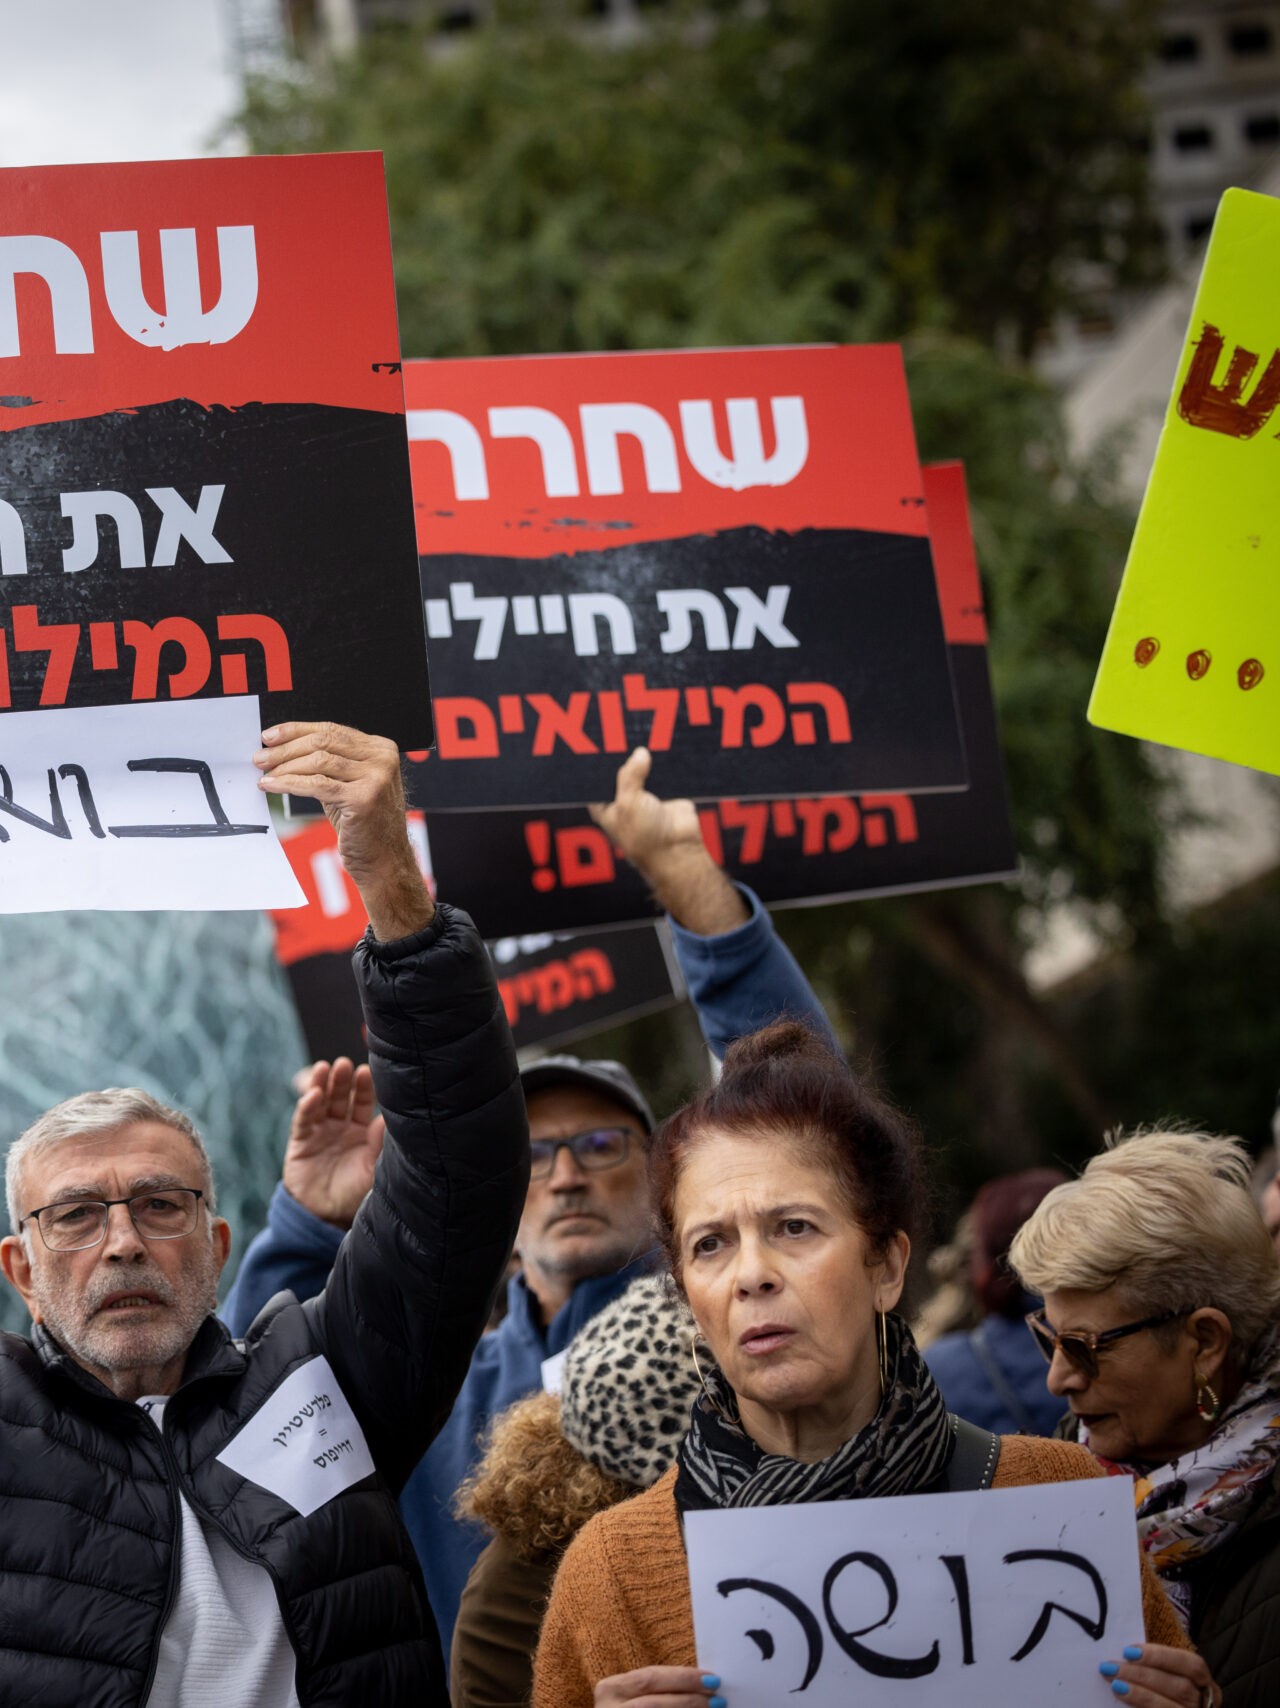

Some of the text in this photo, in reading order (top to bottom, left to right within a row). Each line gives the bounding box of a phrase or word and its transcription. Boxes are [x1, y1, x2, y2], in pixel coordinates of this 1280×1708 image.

[406, 396, 810, 501] שחרר
[61, 484, 234, 573] את
[426, 582, 800, 661] את חיילי
[407, 673, 852, 762] המילואים
[716, 1548, 1109, 1693] בושה
